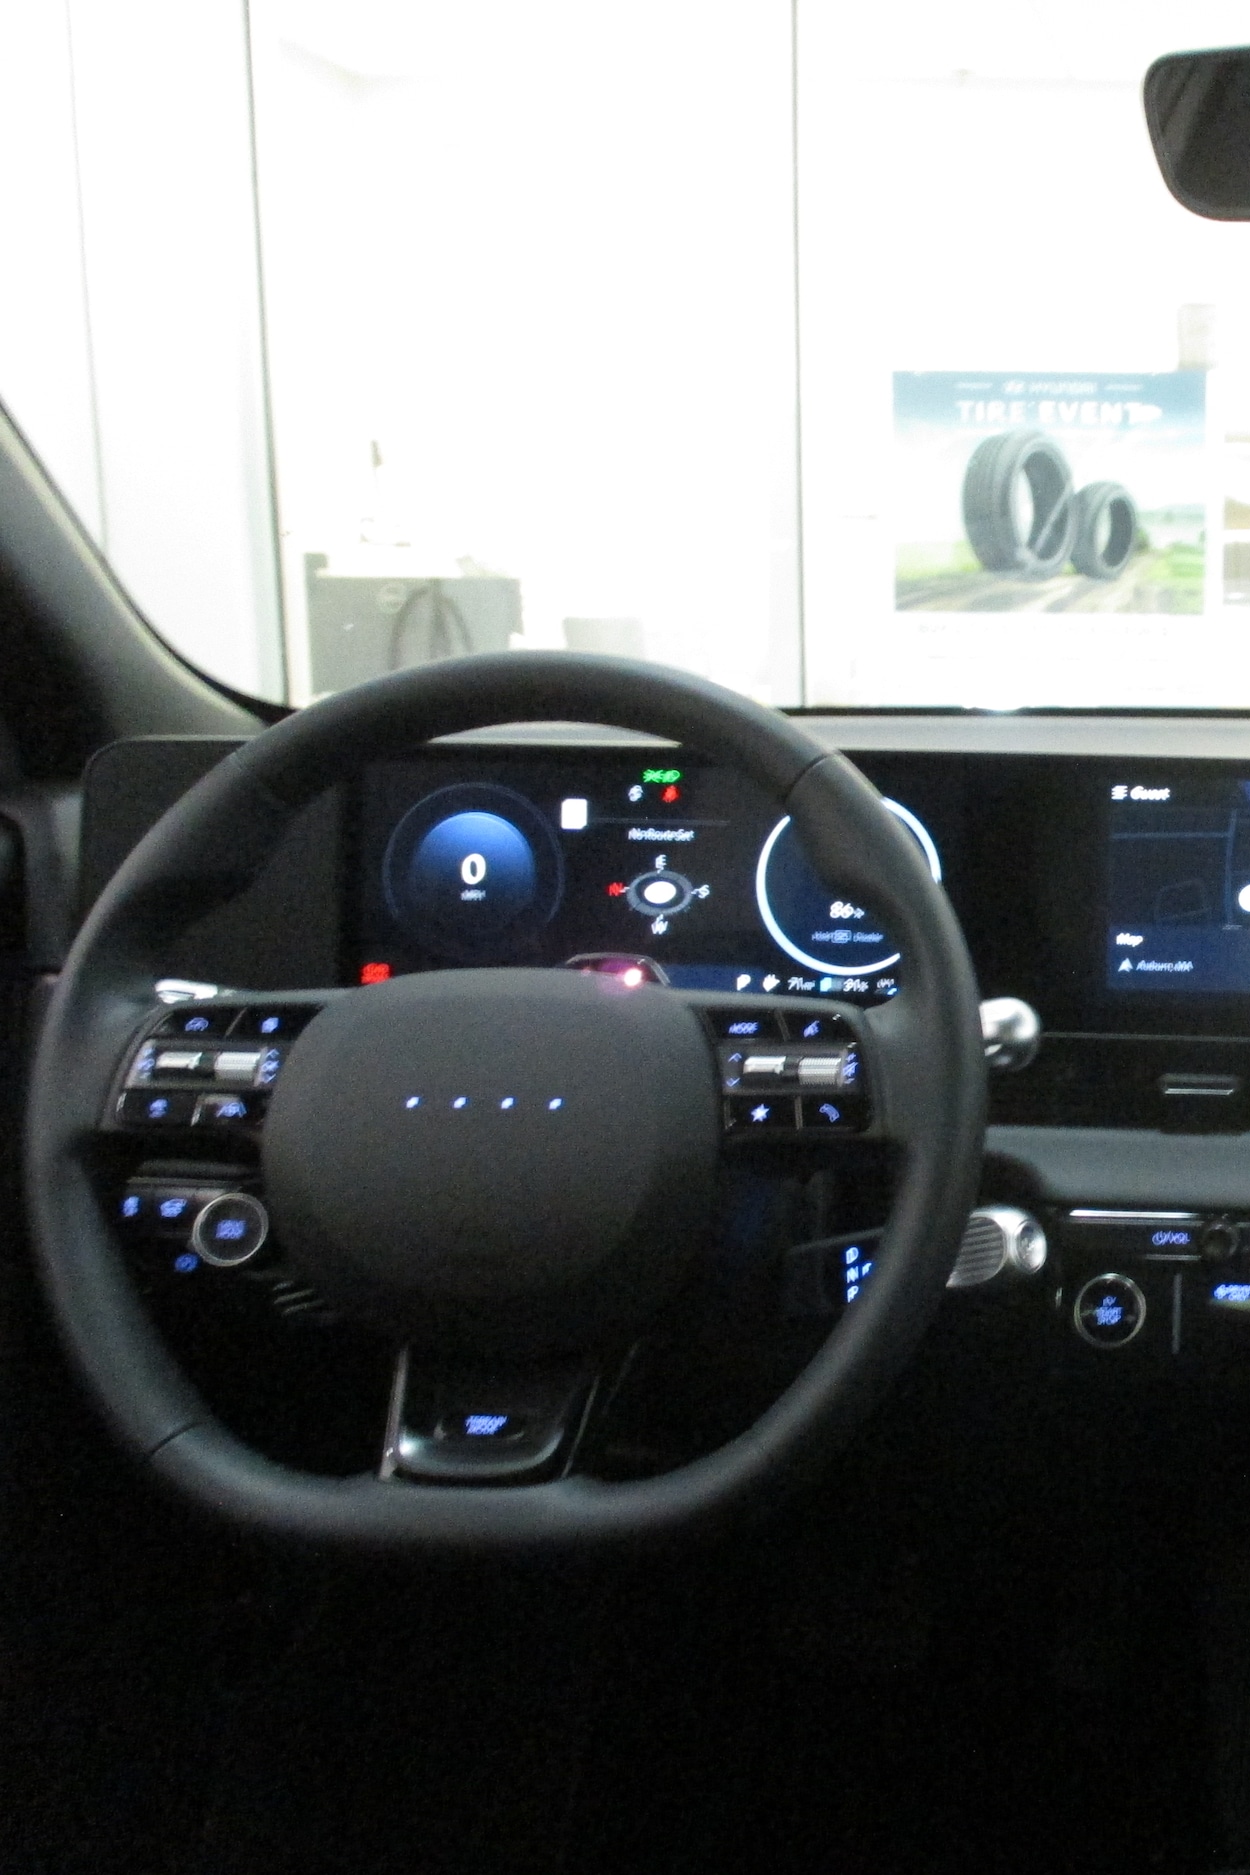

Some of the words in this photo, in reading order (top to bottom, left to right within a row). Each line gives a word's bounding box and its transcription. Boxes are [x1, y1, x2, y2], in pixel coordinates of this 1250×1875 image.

[958, 401, 1026, 424] TIRE
[1038, 401, 1143, 424] EVENT
[1129, 785, 1171, 801] Guest
[461, 853, 487, 885] 0
[737, 974, 752, 992] P
[845, 1246, 860, 1265] D
[846, 1265, 860, 1284] N
